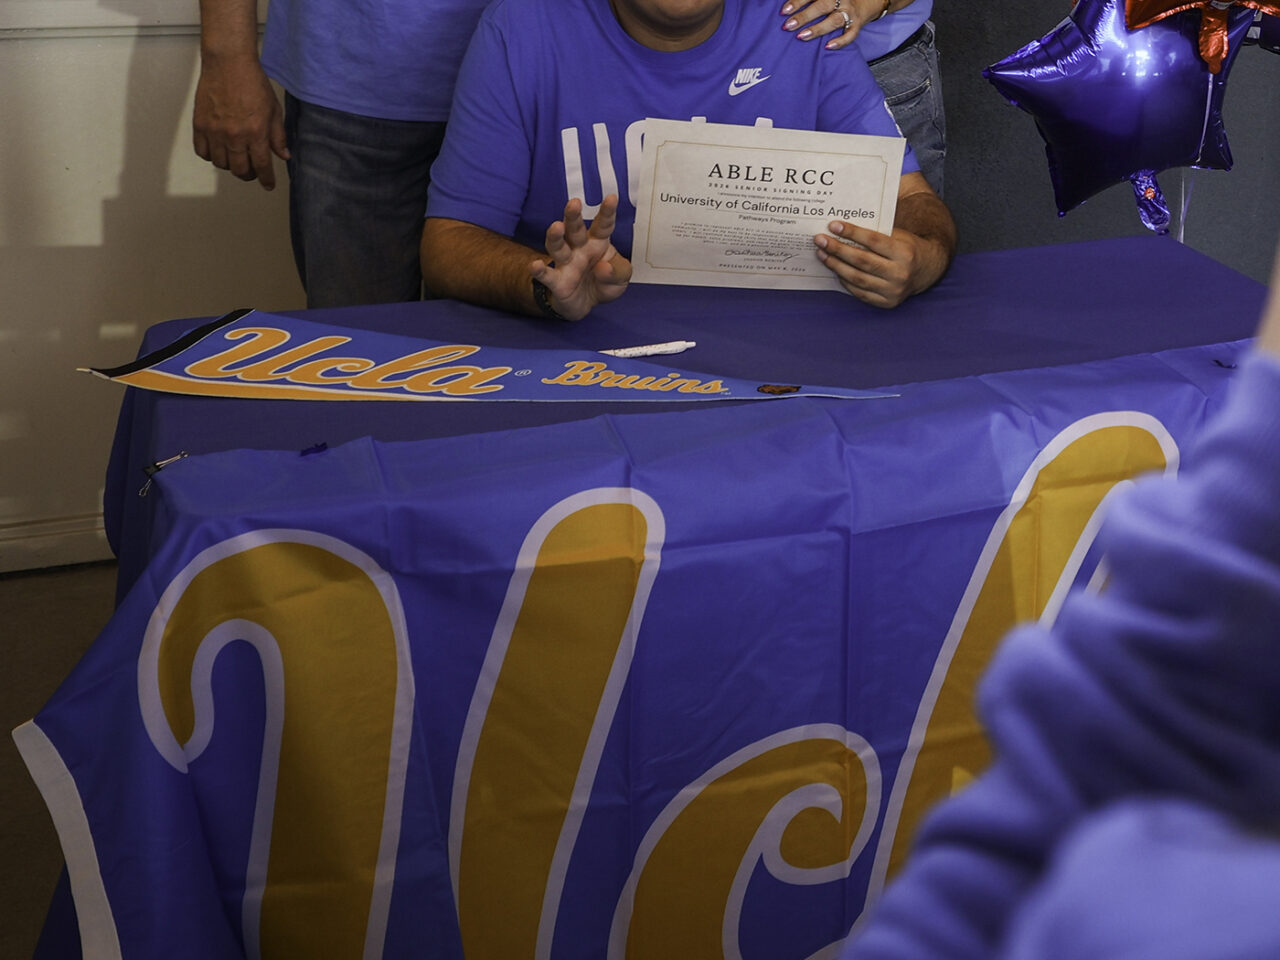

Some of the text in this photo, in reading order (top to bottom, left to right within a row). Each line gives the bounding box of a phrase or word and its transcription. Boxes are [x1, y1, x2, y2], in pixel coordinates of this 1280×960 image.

[735, 67, 762, 84] NIKE
[708, 163, 835, 186] ABLE RCC
[735, 184, 768, 192] SENIOR
[773, 187, 812, 195] SIGNING
[660, 192, 875, 220] University of California Los Angeles
[770, 217, 797, 225] Program
[184, 327, 513, 395] Ucla
[541, 361, 729, 394] Bruins
